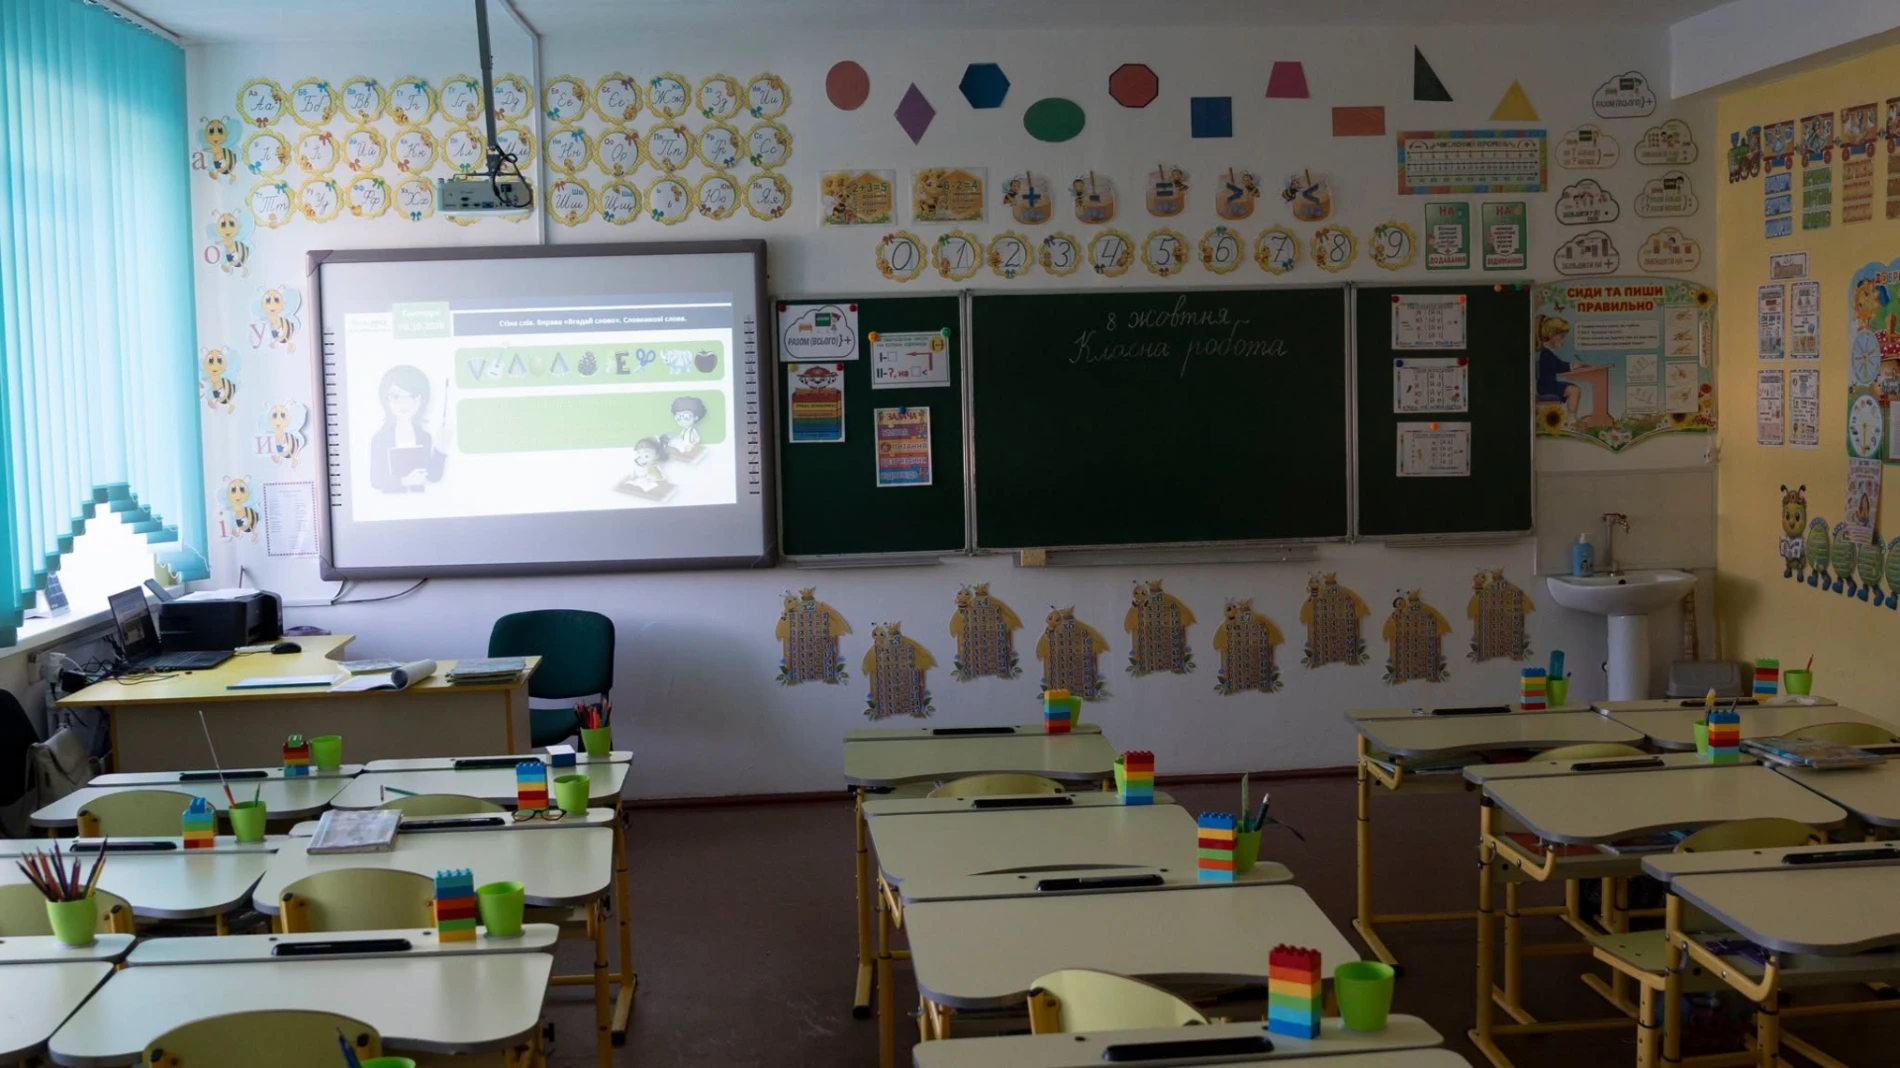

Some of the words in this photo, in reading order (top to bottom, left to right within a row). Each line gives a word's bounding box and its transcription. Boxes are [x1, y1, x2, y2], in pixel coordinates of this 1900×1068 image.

[892, 241, 912, 271] 0
[956, 241, 967, 269] 1
[1004, 241, 1021, 268] 2
[1054, 241, 1071, 268] 3
[1101, 239, 1122, 267] 4
[1156, 238, 1175, 266] 5
[1214, 237, 1232, 263] 6
[1271, 236, 1288, 263] 7
[1330, 235, 1346, 262] 8
[1386, 230, 1403, 259] 9
[1567, 287, 1602, 299] СИДИ
[1605, 286, 1621, 297] ТА
[1624, 285, 1663, 297] ПИШИ
[1875, 272, 1900, 285] ДОБР
[1106, 312, 1116, 331] 8
[1128, 295, 1230, 329] жовтня
[1577, 301, 1654, 312] ПРАВИЛЬНО
[1069, 330, 1171, 364] Класна
[1180, 319, 1289, 379] робота
